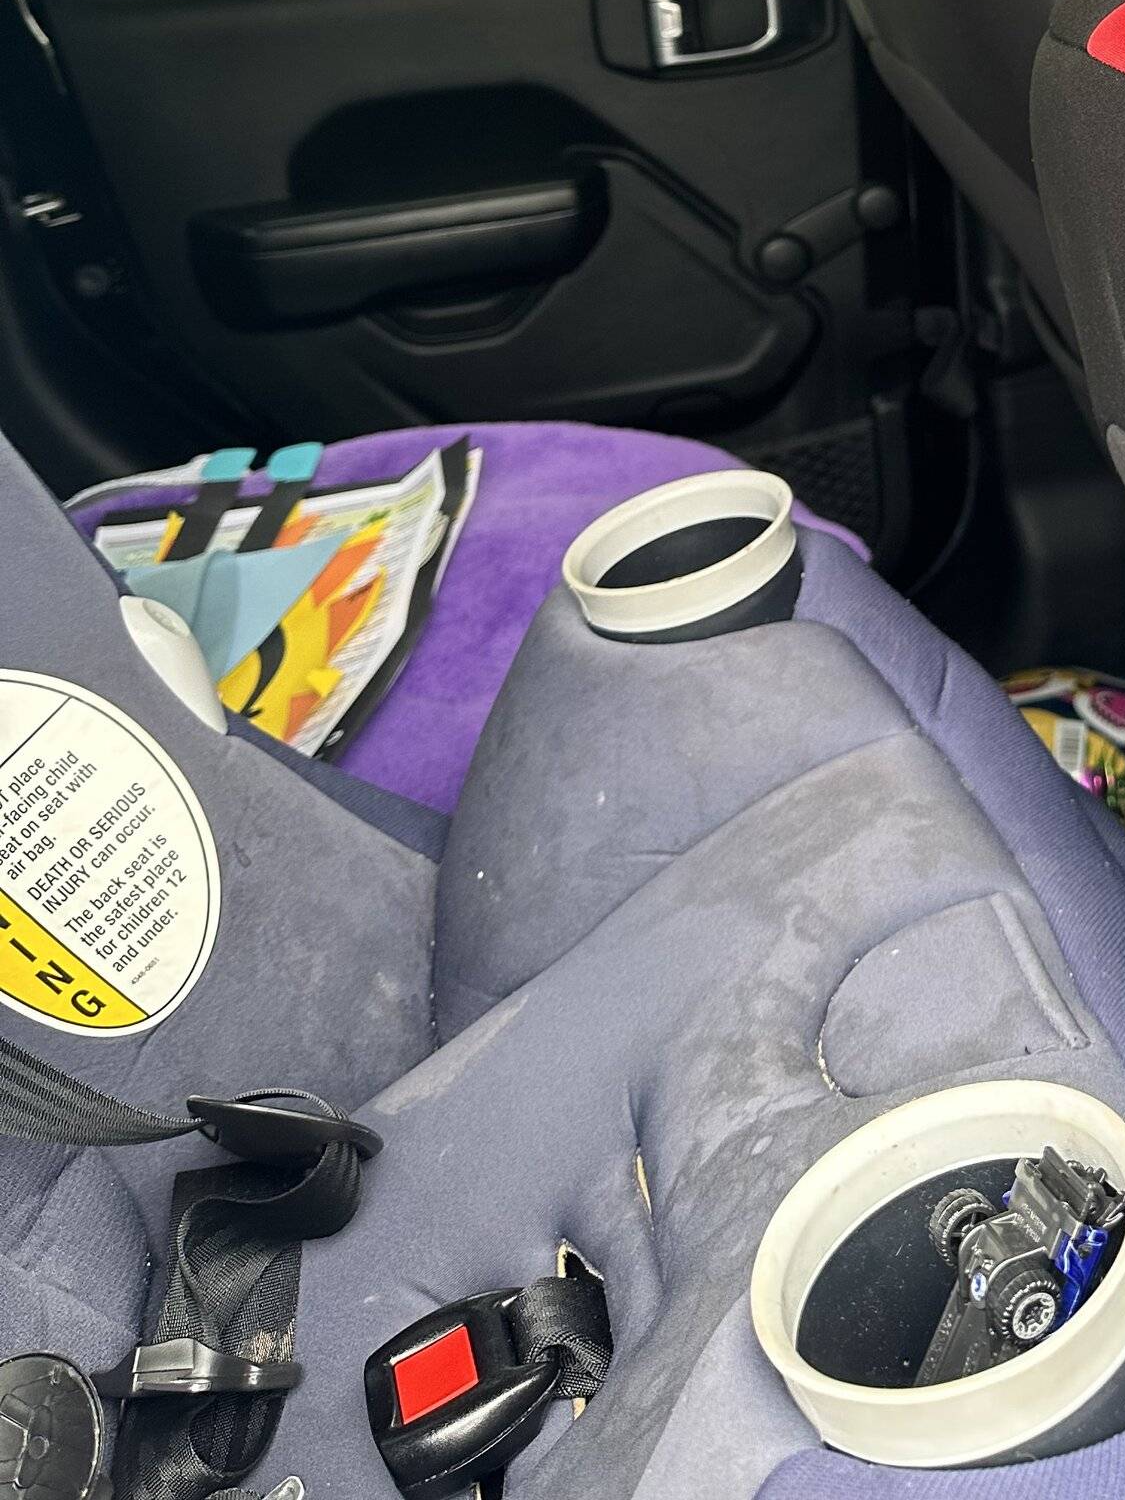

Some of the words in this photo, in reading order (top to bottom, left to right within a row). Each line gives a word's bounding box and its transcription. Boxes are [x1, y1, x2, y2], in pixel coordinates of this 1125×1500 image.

[8, 758, 45, 796] place
[20, 820, 40, 839] on
[38, 790, 69, 822] seat
[65, 763, 97, 793] with
[45, 750, 79, 786] child
[7, 860, 26, 880] air
[22, 836, 57, 862] bag.
[27, 856, 74, 901] DEATH
[69, 838, 93, 860] OR
[88, 782, 146, 840] SERIOUS
[42, 865, 90, 914] INJURY
[91, 843, 118, 869] can
[115, 804, 156, 844] occur.
[64, 909, 94, 933] The
[89, 877, 126, 910] back
[124, 847, 155, 878] seat
[149, 834, 167, 849] is
[80, 924, 106, 947] the
[104, 884, 146, 926] safest
[143, 850, 179, 889] place
[95, 938, 118, 960] for
[117, 888, 170, 940] children
[166, 868, 187, 888] 12
[112, 944, 139, 973] and
[136, 908, 179, 948] under.
[0, 912, 107, 1018] ING
